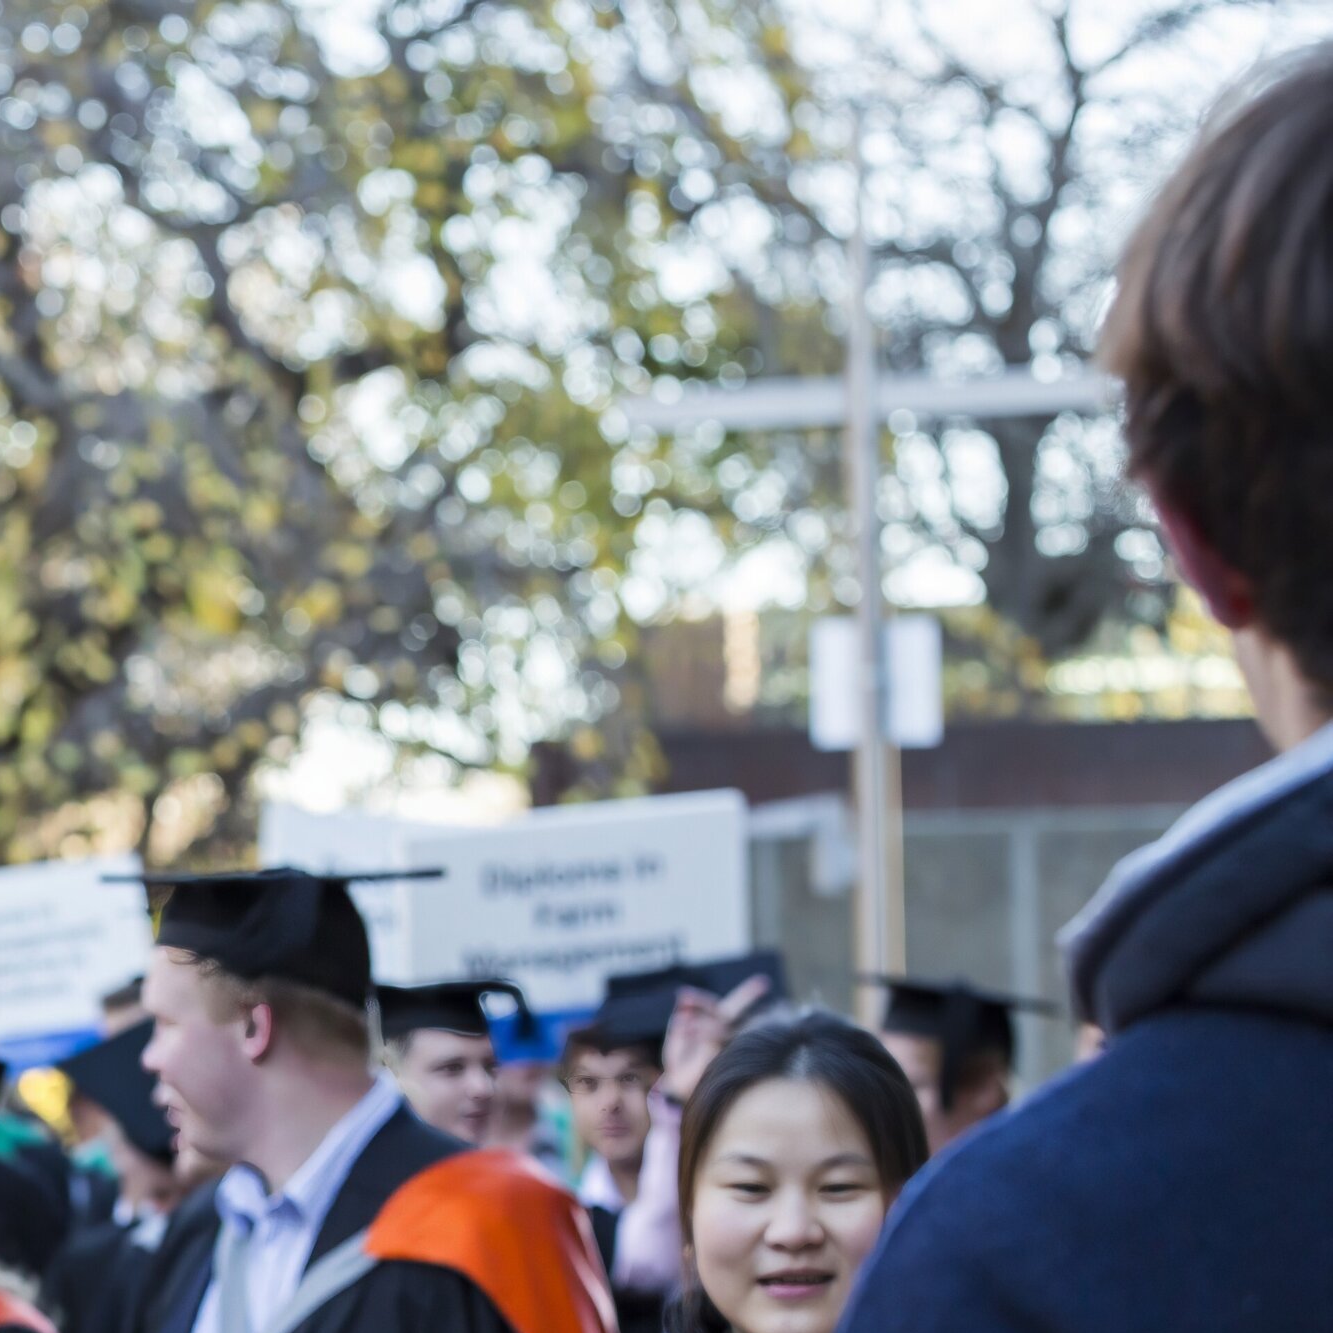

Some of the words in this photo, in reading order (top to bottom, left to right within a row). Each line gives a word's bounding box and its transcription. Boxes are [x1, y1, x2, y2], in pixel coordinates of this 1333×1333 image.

[480, 857, 626, 896] Diploma
[630, 852, 668, 881] in
[533, 899, 623, 930] Farm
